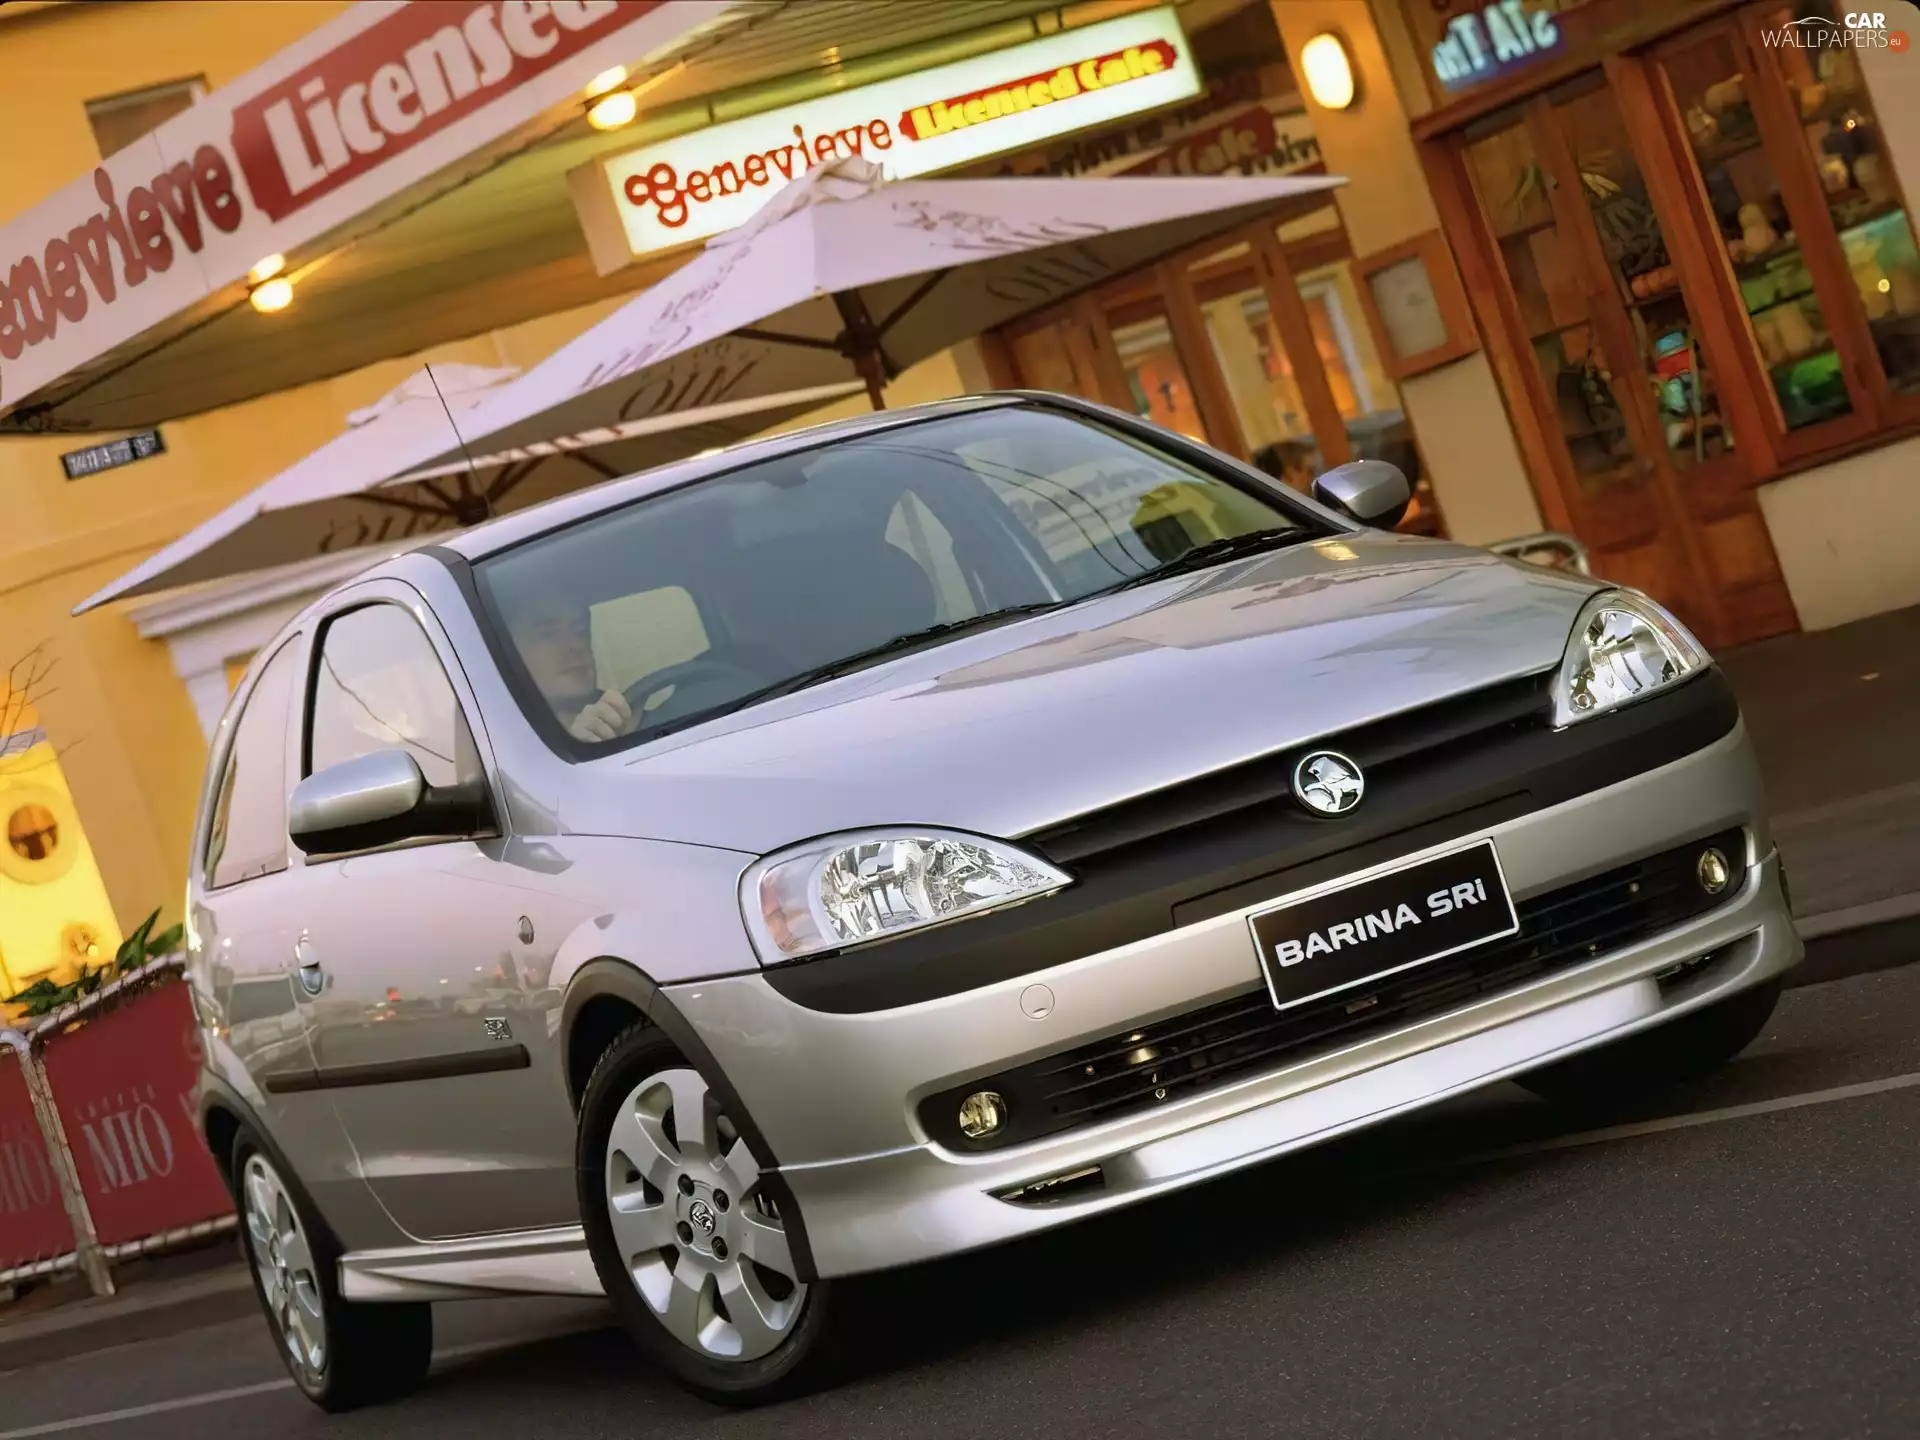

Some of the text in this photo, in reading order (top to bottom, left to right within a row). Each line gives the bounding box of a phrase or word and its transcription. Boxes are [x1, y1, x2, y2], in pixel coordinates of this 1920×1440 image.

[1275, 878, 1487, 967] BARINA SRi
[80, 1103, 173, 1193] MIO
